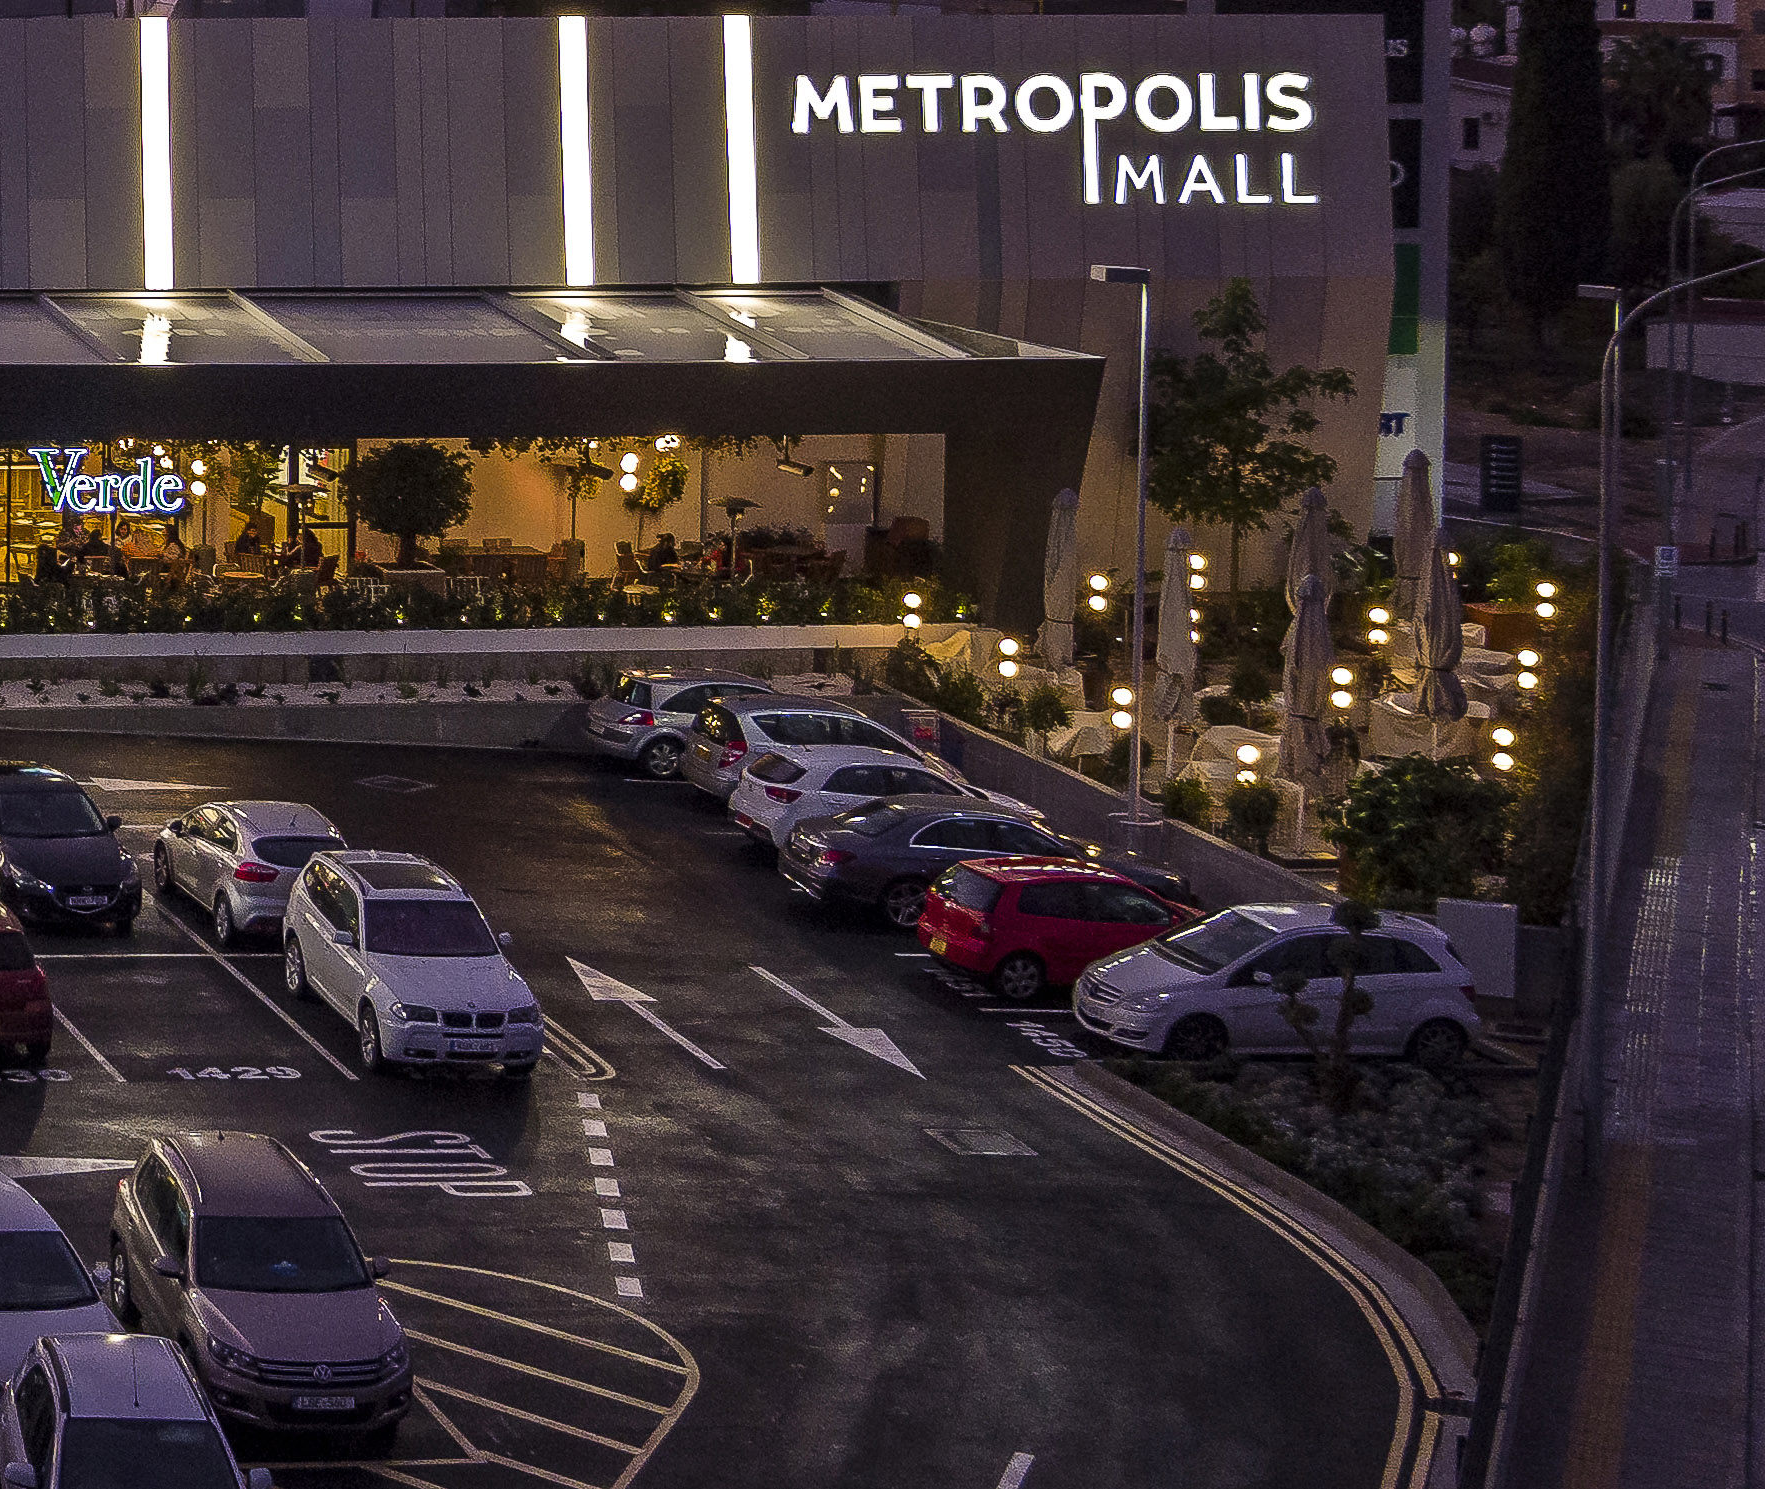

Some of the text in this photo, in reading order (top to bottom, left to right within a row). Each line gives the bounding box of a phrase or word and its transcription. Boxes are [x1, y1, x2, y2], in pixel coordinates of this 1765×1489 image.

[791, 72, 1314, 204] METROPOLIS
[1114, 152, 1320, 204] MALL
[27, 447, 185, 513] Verde
[171, 1066, 302, 1080] 1429
[308, 1129, 534, 1198] STOP
